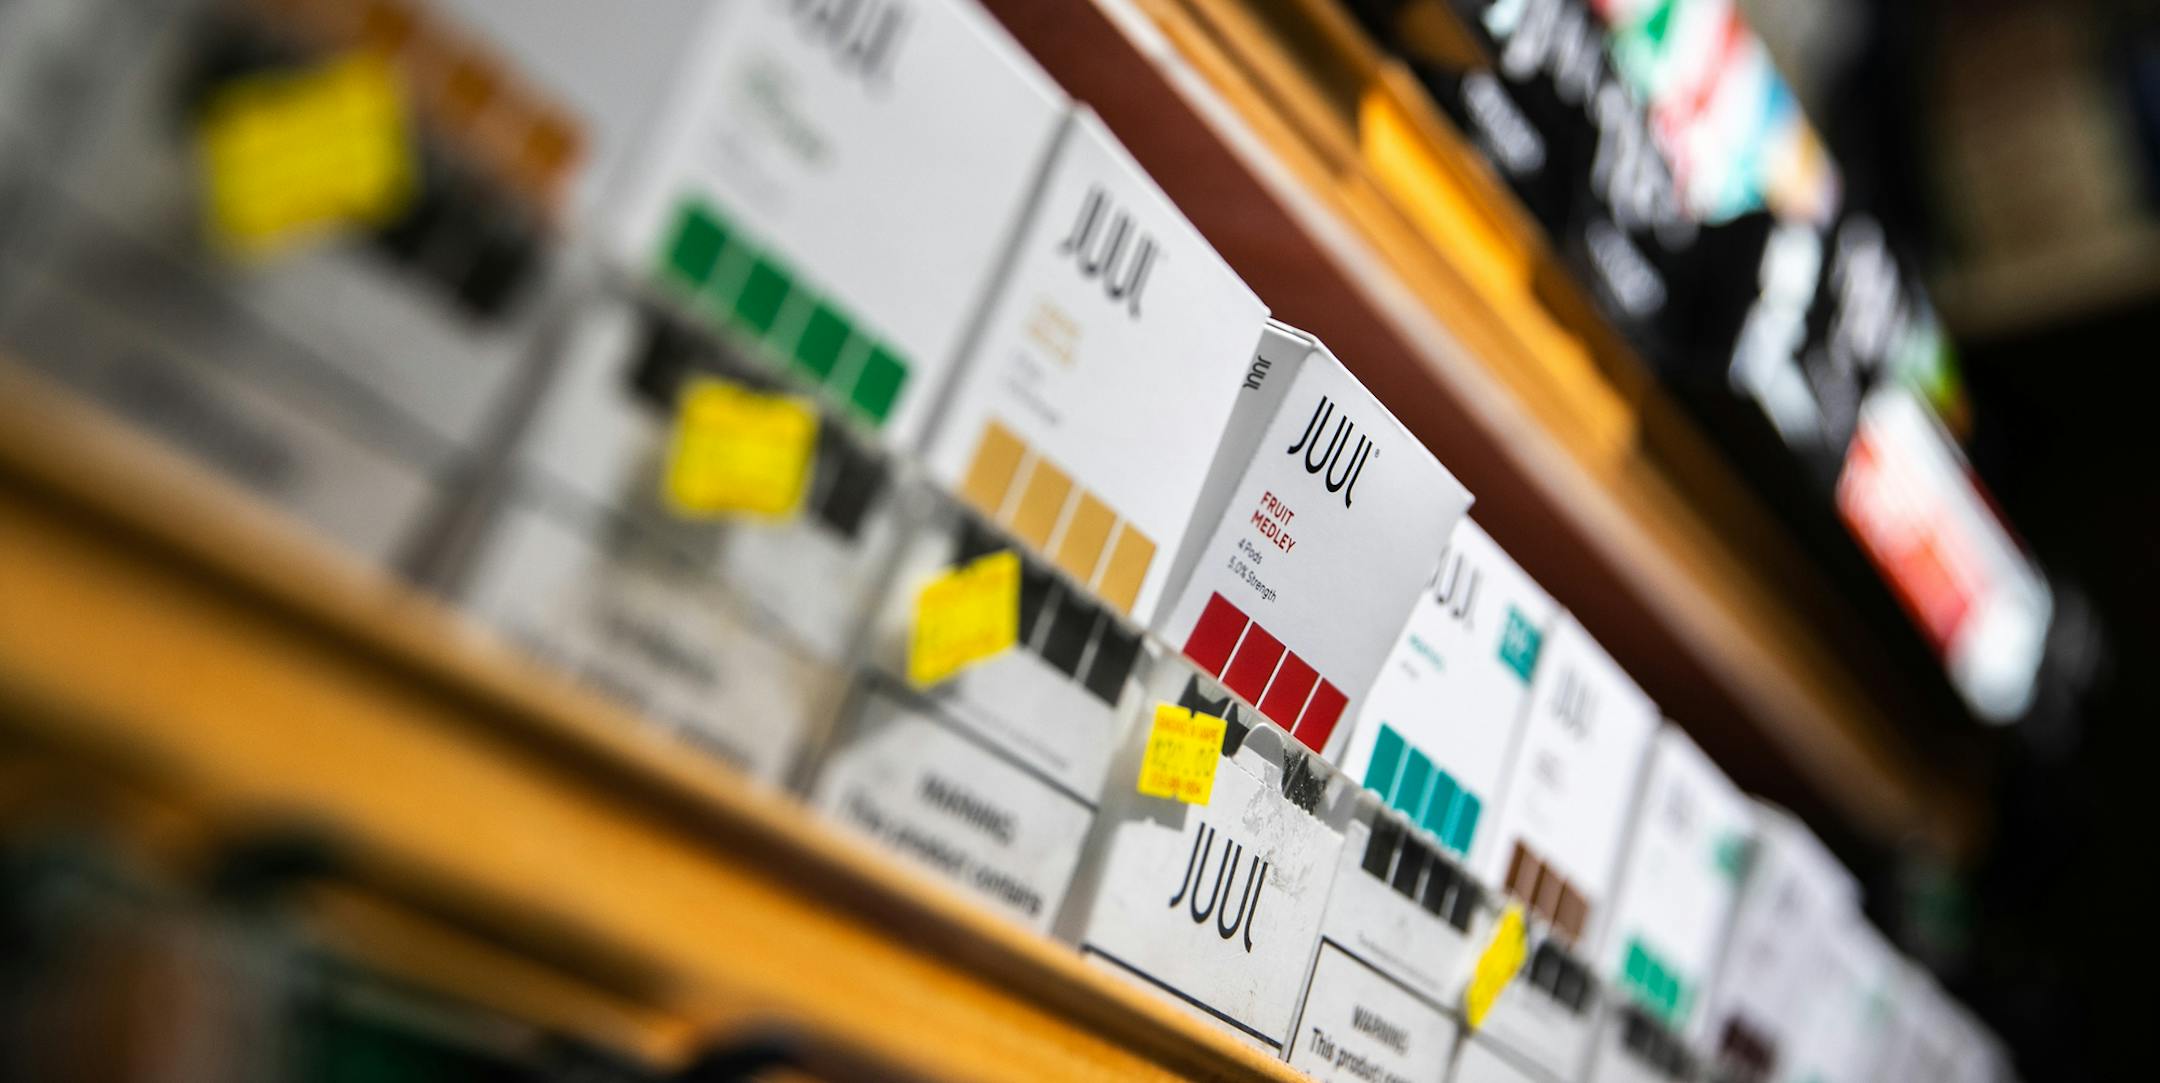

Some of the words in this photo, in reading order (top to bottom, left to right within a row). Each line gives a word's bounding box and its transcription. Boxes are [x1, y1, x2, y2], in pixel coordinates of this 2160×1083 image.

[1243, 355, 1272, 390] JUUL
[1287, 395, 1373, 509] JUUL
[1260, 490, 1295, 526] FRUIT
[1238, 538, 1246, 550] 4
[1244, 541, 1264, 565] Pods
[1250, 509, 1297, 554] MEDLEY
[1227, 555, 1248, 579] 5.0%
[1246, 570, 1277, 603] Strength
[1168, 820, 1269, 953] JUUL
[1310, 1026, 1336, 1062] This
